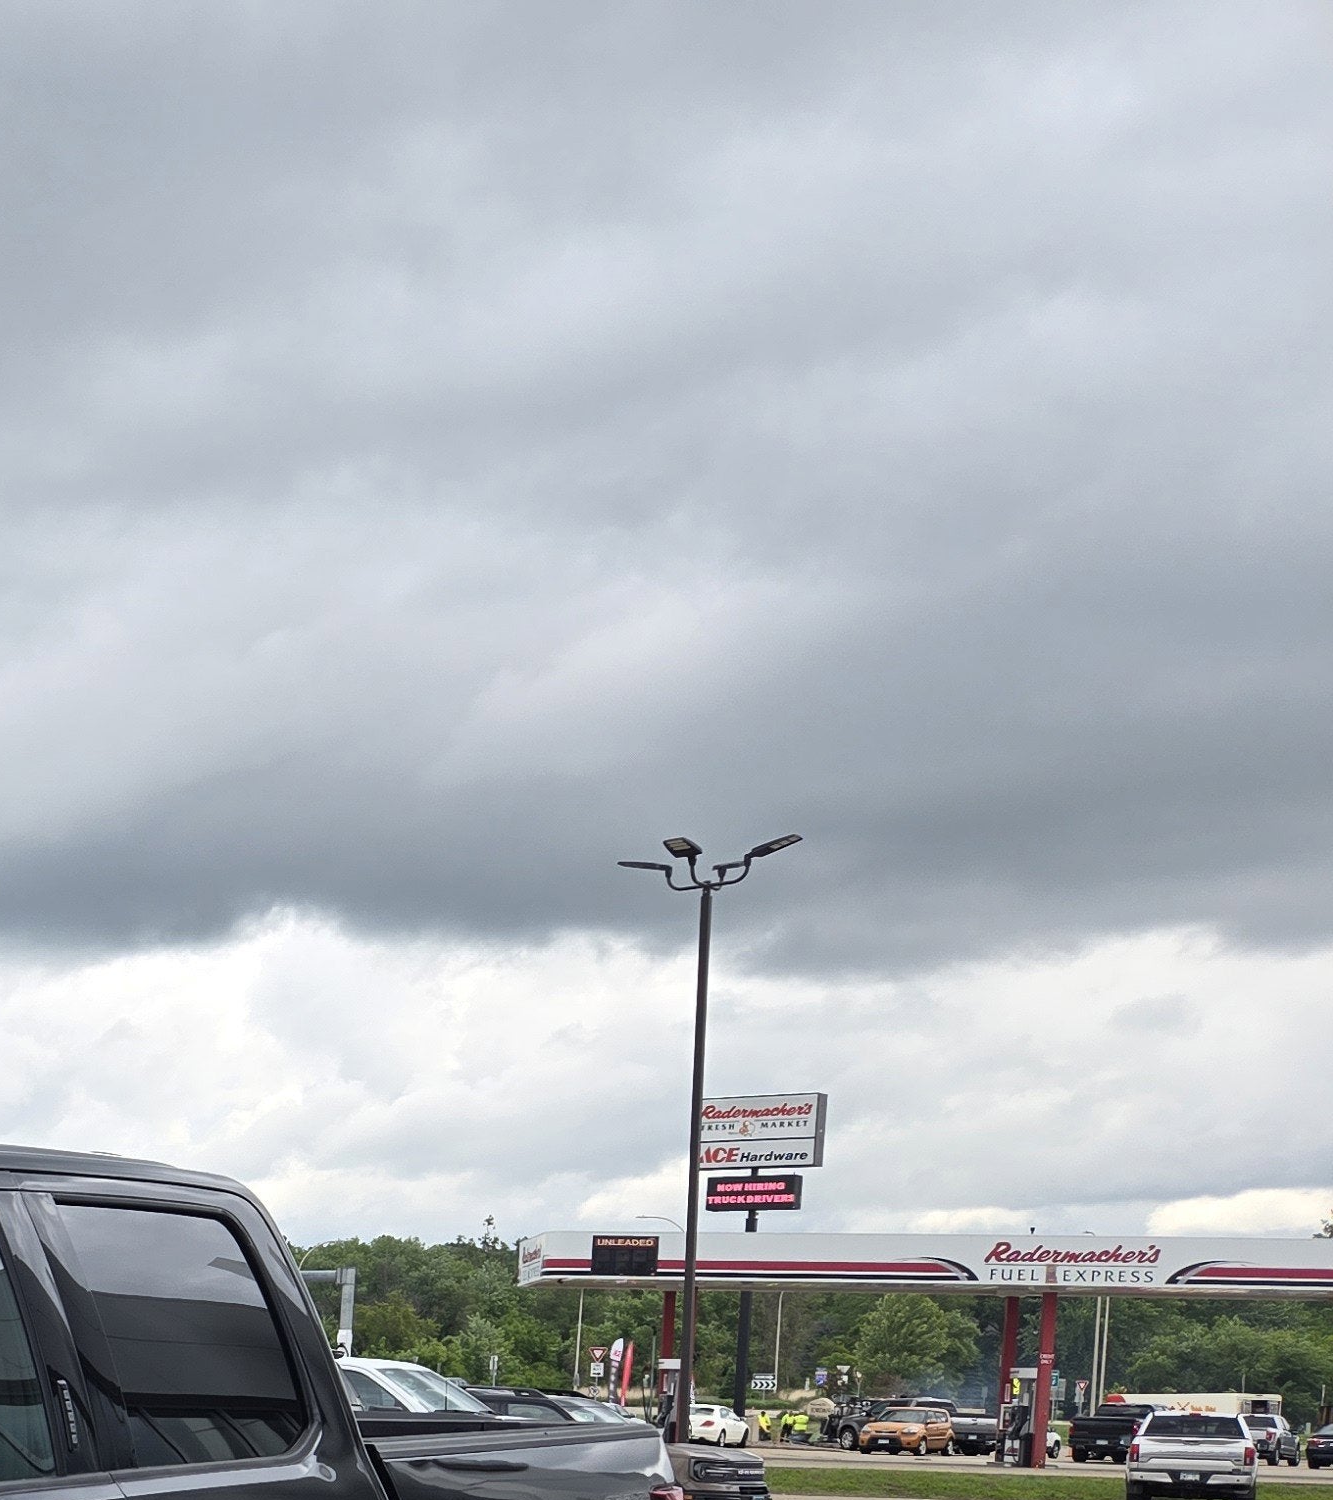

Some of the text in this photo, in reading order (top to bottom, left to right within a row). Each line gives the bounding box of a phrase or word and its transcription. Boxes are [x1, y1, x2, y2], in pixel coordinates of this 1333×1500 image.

[701, 1102, 813, 1120] Radermacher's
[760, 1120, 808, 1129] MARKET
[700, 1146, 808, 1164] ACE Hardware
[716, 1182, 785, 1192] NOW HIRING
[707, 1194, 795, 1205] TRUCK DRIVERS
[597, 1238, 653, 1247] UNLEADED
[984, 1241, 1161, 1264] Radermacher's
[989, 1268, 1154, 1283] FUEL EXPRESS
